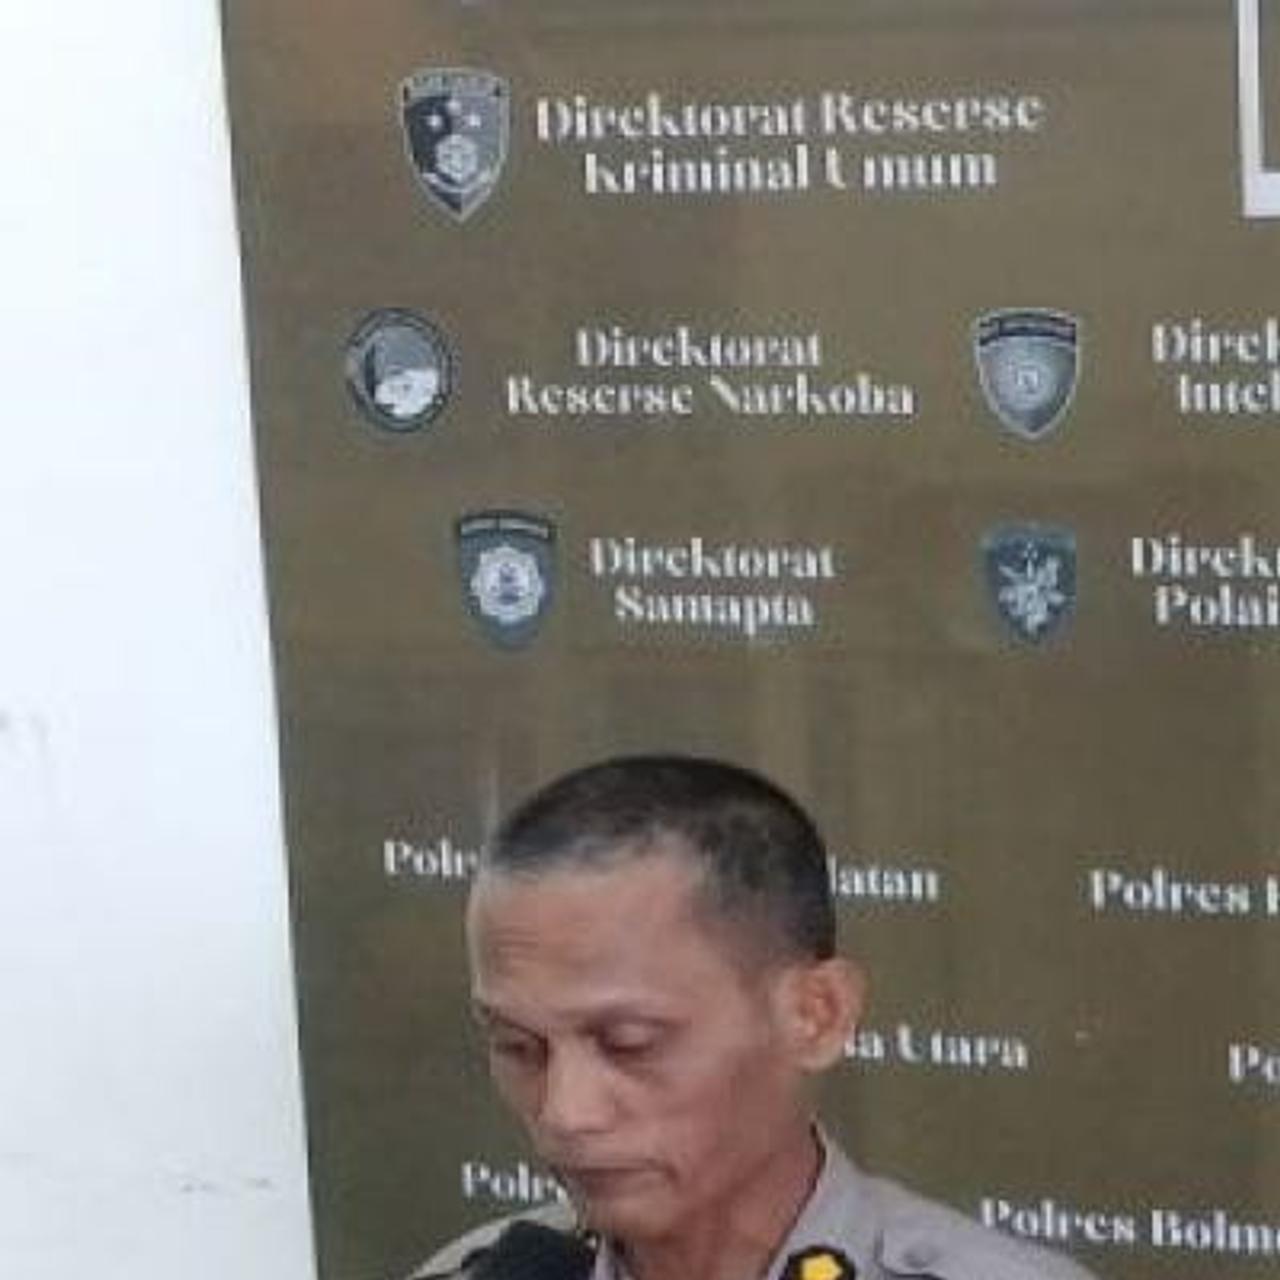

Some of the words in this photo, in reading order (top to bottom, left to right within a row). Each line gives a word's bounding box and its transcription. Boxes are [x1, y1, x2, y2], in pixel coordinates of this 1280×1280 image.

[537, 93, 807, 141] Direktorat
[822, 91, 1044, 134] Reserse
[583, 146, 808, 194] Kriminal
[826, 148, 997, 188] Umum
[577, 327, 821, 367] Direktorat
[507, 376, 693, 414] Reserse
[709, 373, 914, 415] Narkoba
[590, 538, 835, 579] Direktorat
[615, 586, 814, 637] Samapta
[384, 838, 479, 877] Polr
[1091, 868, 1250, 914] Polres
[981, 1198, 1137, 1244] Polres
